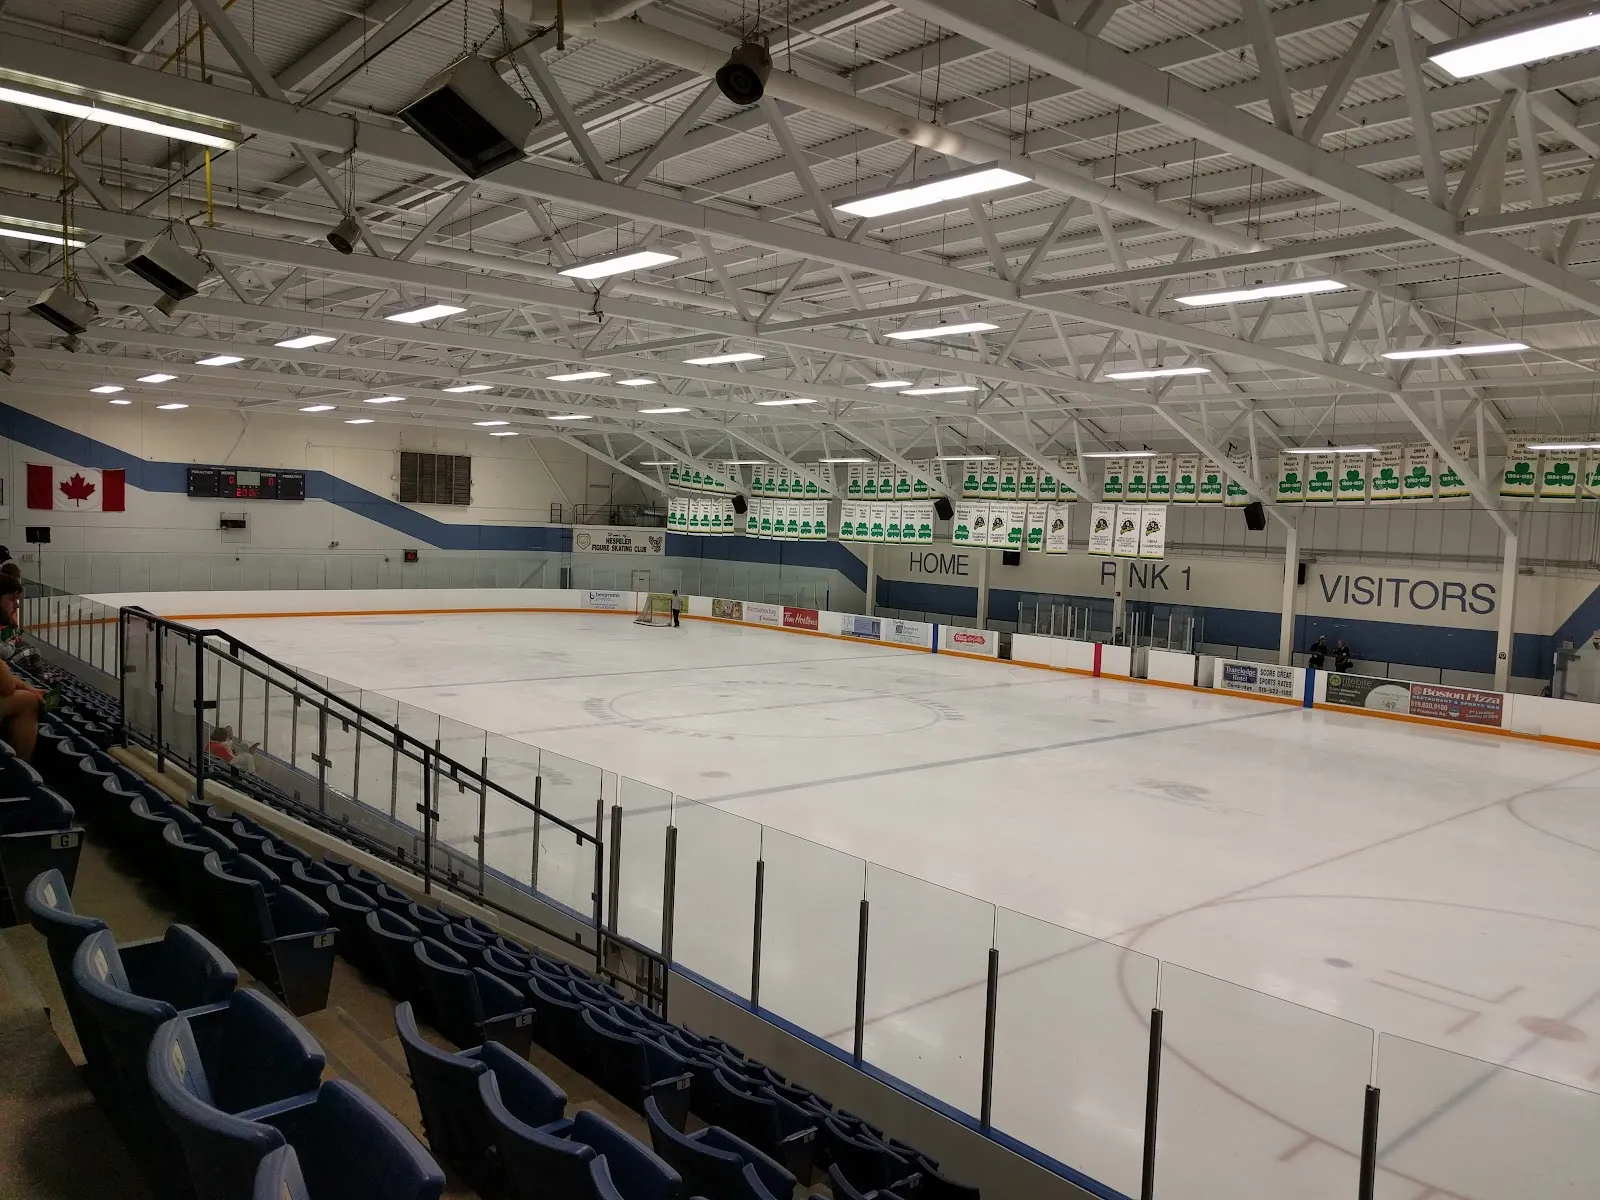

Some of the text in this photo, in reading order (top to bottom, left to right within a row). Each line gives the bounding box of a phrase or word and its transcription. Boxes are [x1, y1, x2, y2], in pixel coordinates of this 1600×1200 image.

[910, 552, 969, 575] HOME
[1101, 561, 1191, 590] RNK 1
[1319, 574, 1496, 614] VISITORS
[784, 612, 794, 623] Tim
[795, 613, 817, 626] Hortons
[1226, 666, 1256, 677] Travelodge
[1260, 668, 1292, 678] SCORE GREAT
[1259, 678, 1292, 688] SPORTS RATES
[1342, 677, 1372, 687] ritebite
[1412, 696, 1452, 704] RESTAURANT
[1423, 688, 1500, 704] Boston Pizza
[60, 834, 69, 848] G
[321, 935, 327, 946] F
